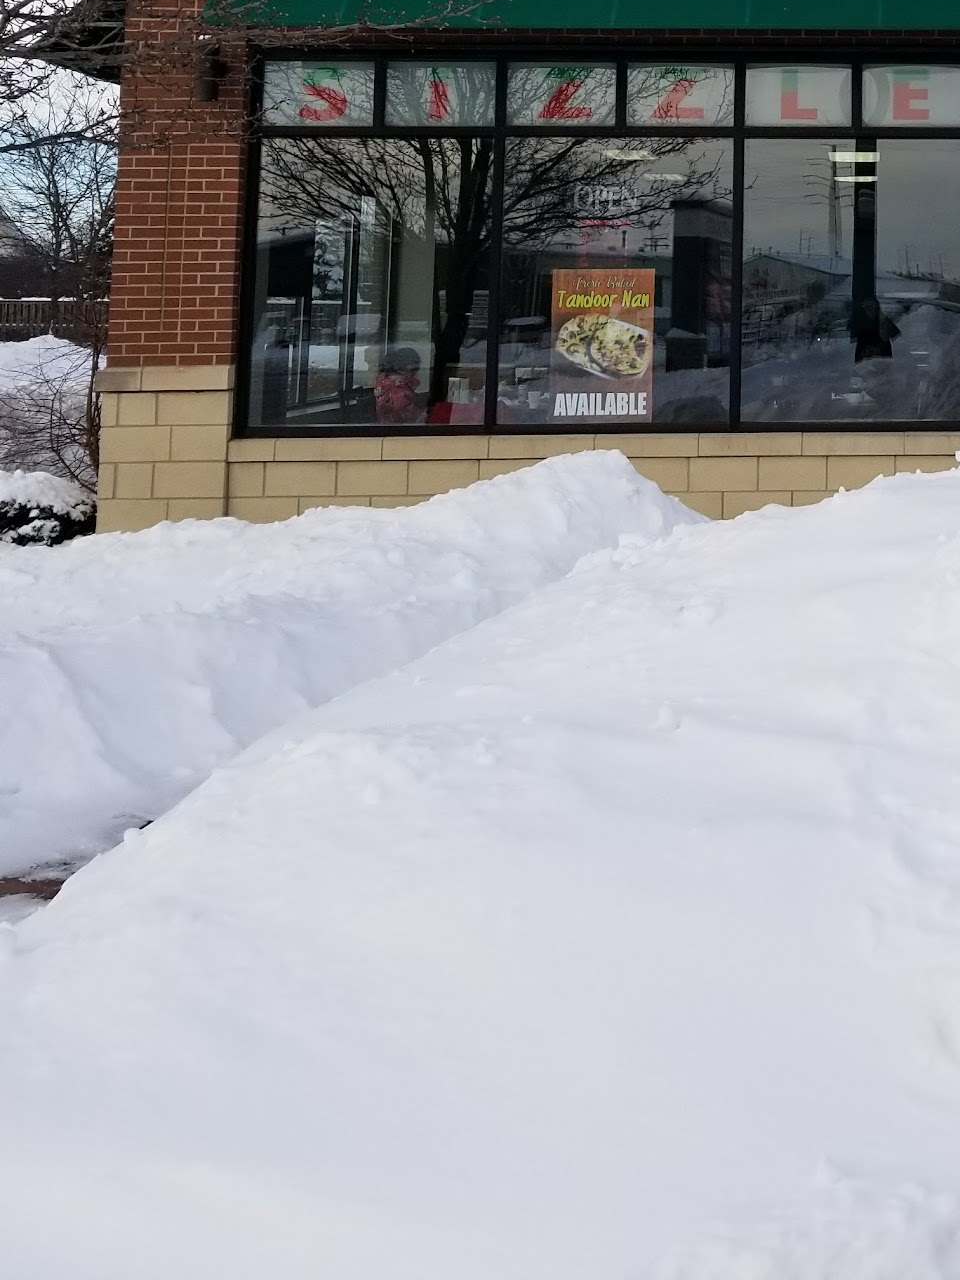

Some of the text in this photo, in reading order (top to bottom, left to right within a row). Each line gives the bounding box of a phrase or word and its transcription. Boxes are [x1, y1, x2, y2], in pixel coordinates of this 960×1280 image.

[573, 184, 639, 211] OPEN
[557, 289, 650, 308] Tandoor Nan
[553, 392, 648, 417] AVAILABLE
